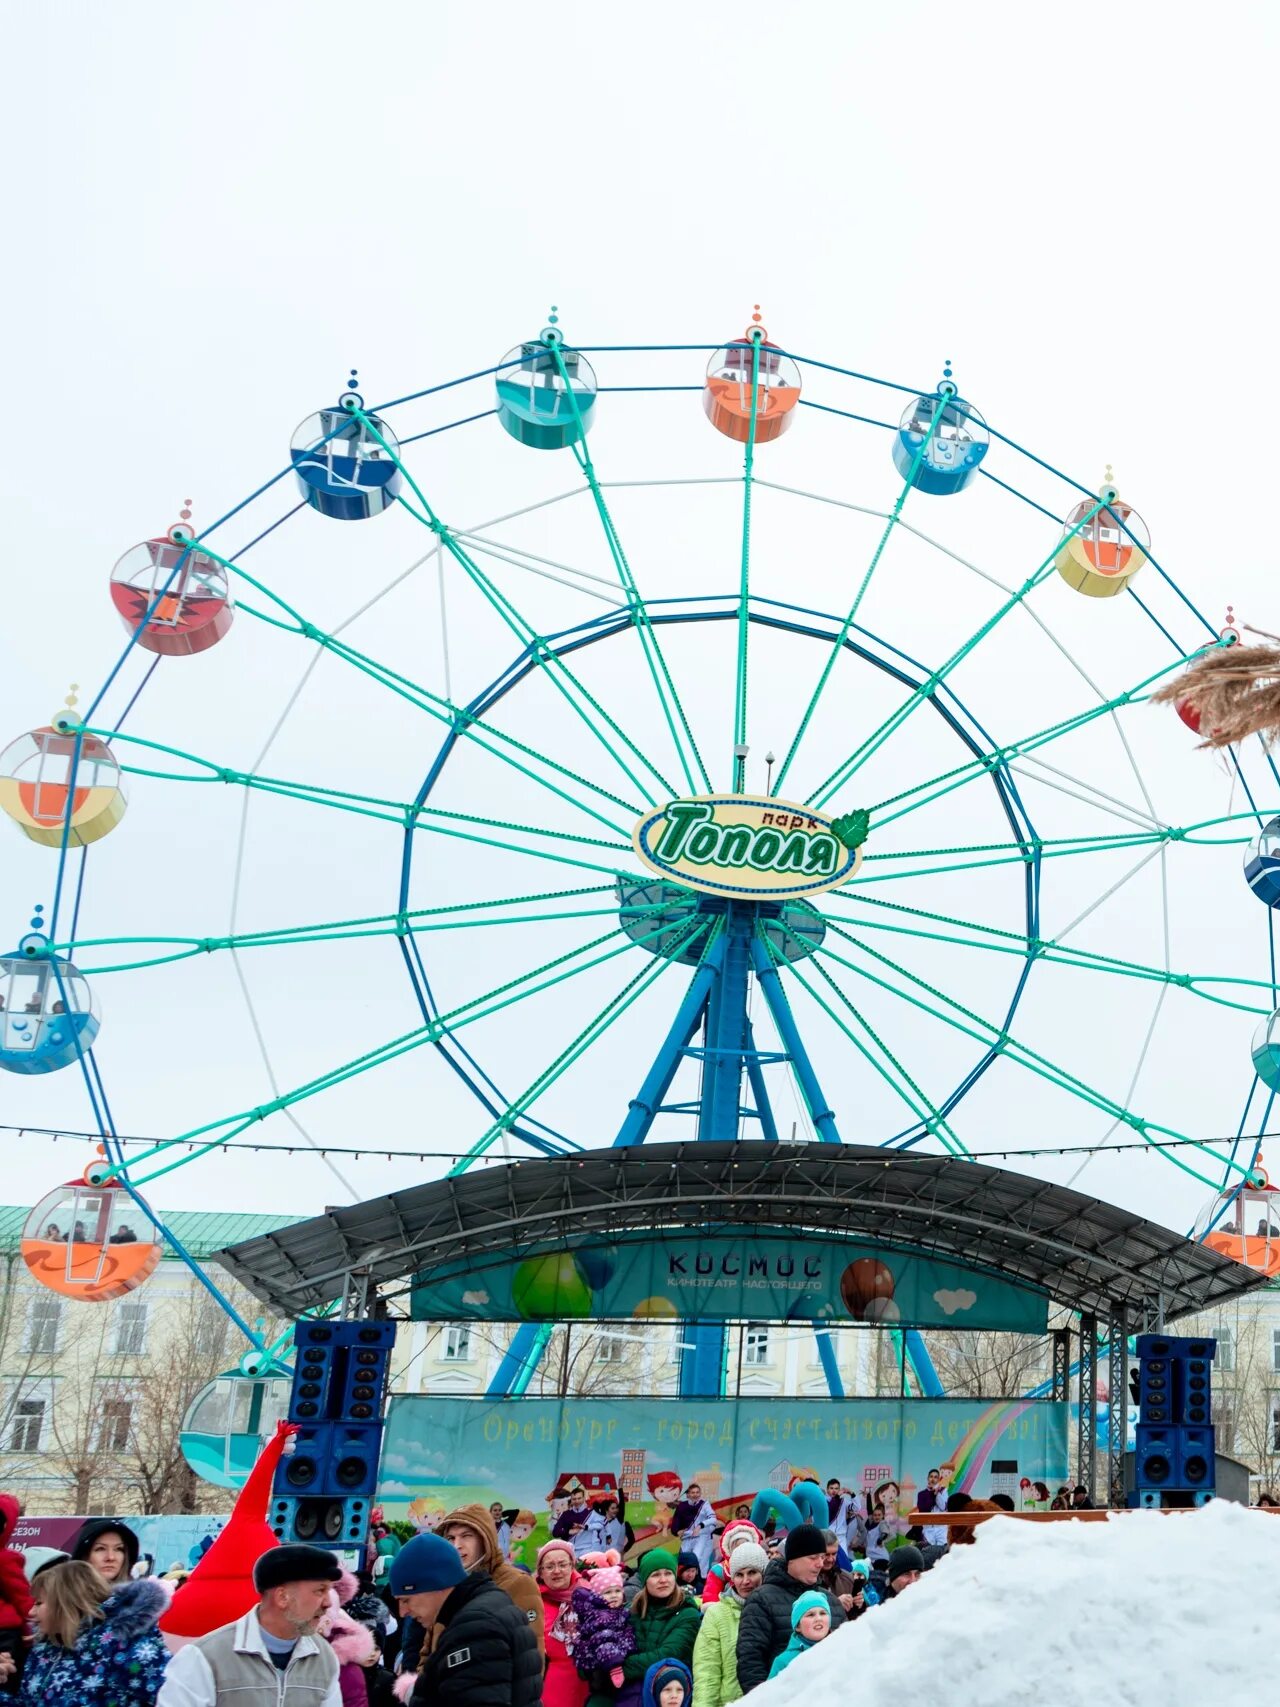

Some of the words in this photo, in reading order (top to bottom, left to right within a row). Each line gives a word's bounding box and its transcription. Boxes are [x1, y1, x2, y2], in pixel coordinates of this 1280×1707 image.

[762, 811, 819, 830] парк
[655, 801, 840, 876] Тополя
[669, 1254, 822, 1277] КОСМОС
[667, 1277, 737, 1288] КИНОТЕАТР
[742, 1280, 822, 1291] НАСТОЯЩЕГО
[483, 1408, 618, 1448] Оренбург
[656, 1417, 734, 1447] город
[749, 1415, 917, 1442] счастливого
